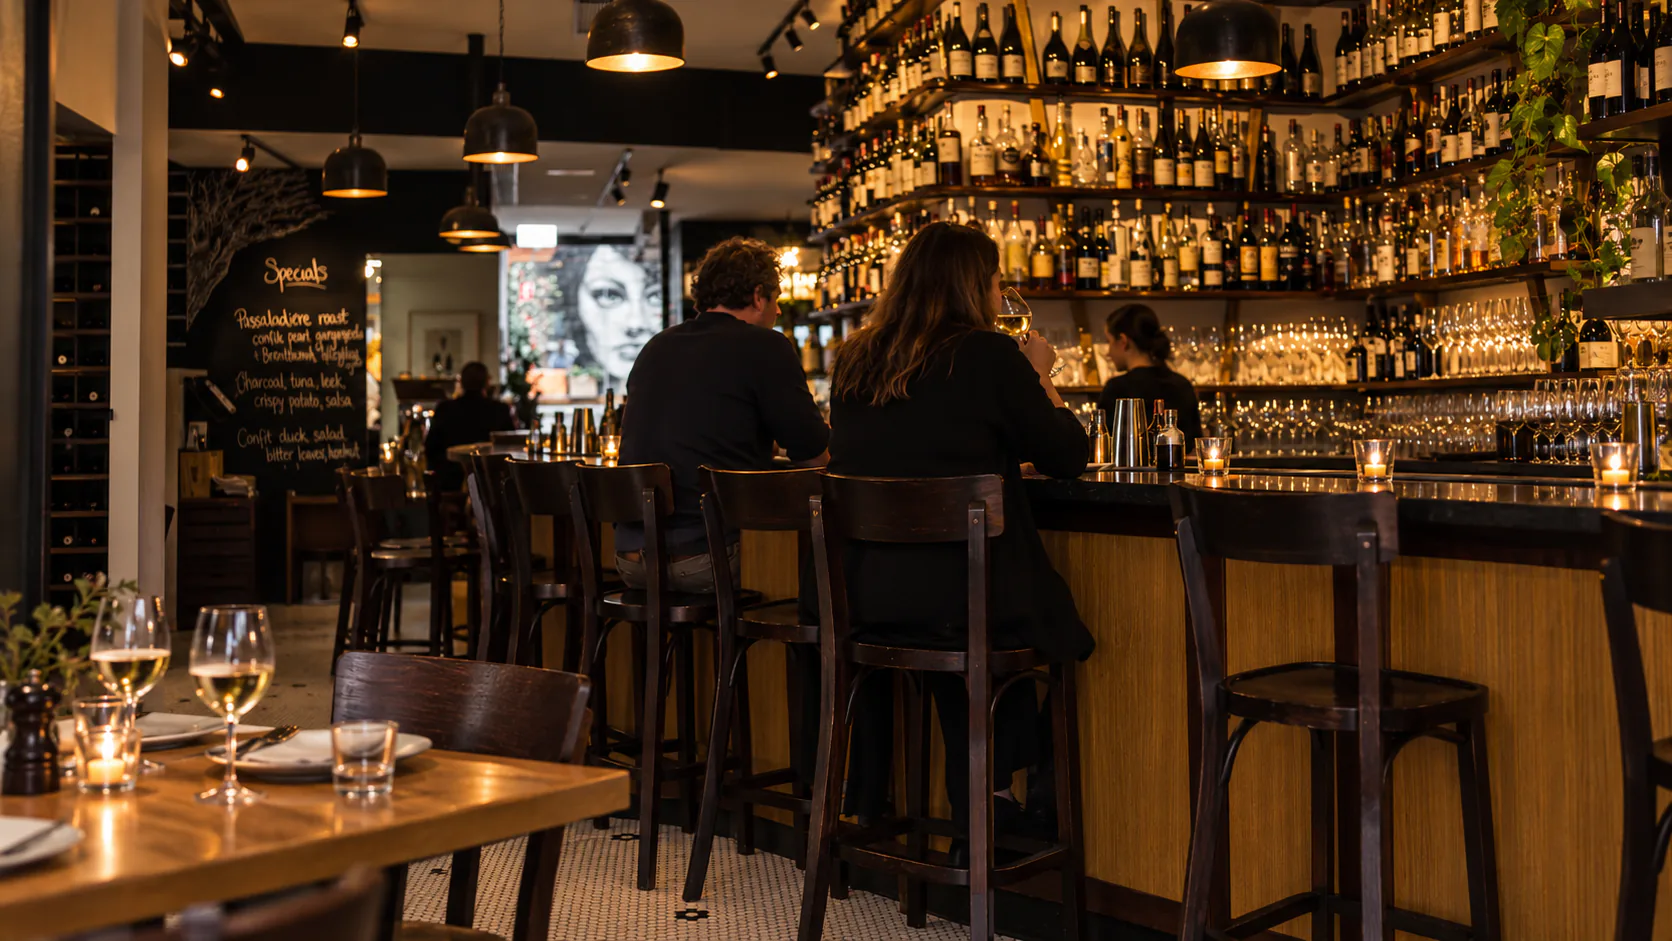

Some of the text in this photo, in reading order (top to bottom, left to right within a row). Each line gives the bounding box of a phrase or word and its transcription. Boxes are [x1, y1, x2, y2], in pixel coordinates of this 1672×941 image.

[264, 257, 328, 293] Specials
[317, 308, 349, 326] roast
[254, 393, 284, 415] crispy
[325, 390, 355, 408] salsa
[237, 424, 347, 449] Confit duck salad
[265, 446, 293, 463] bitter
